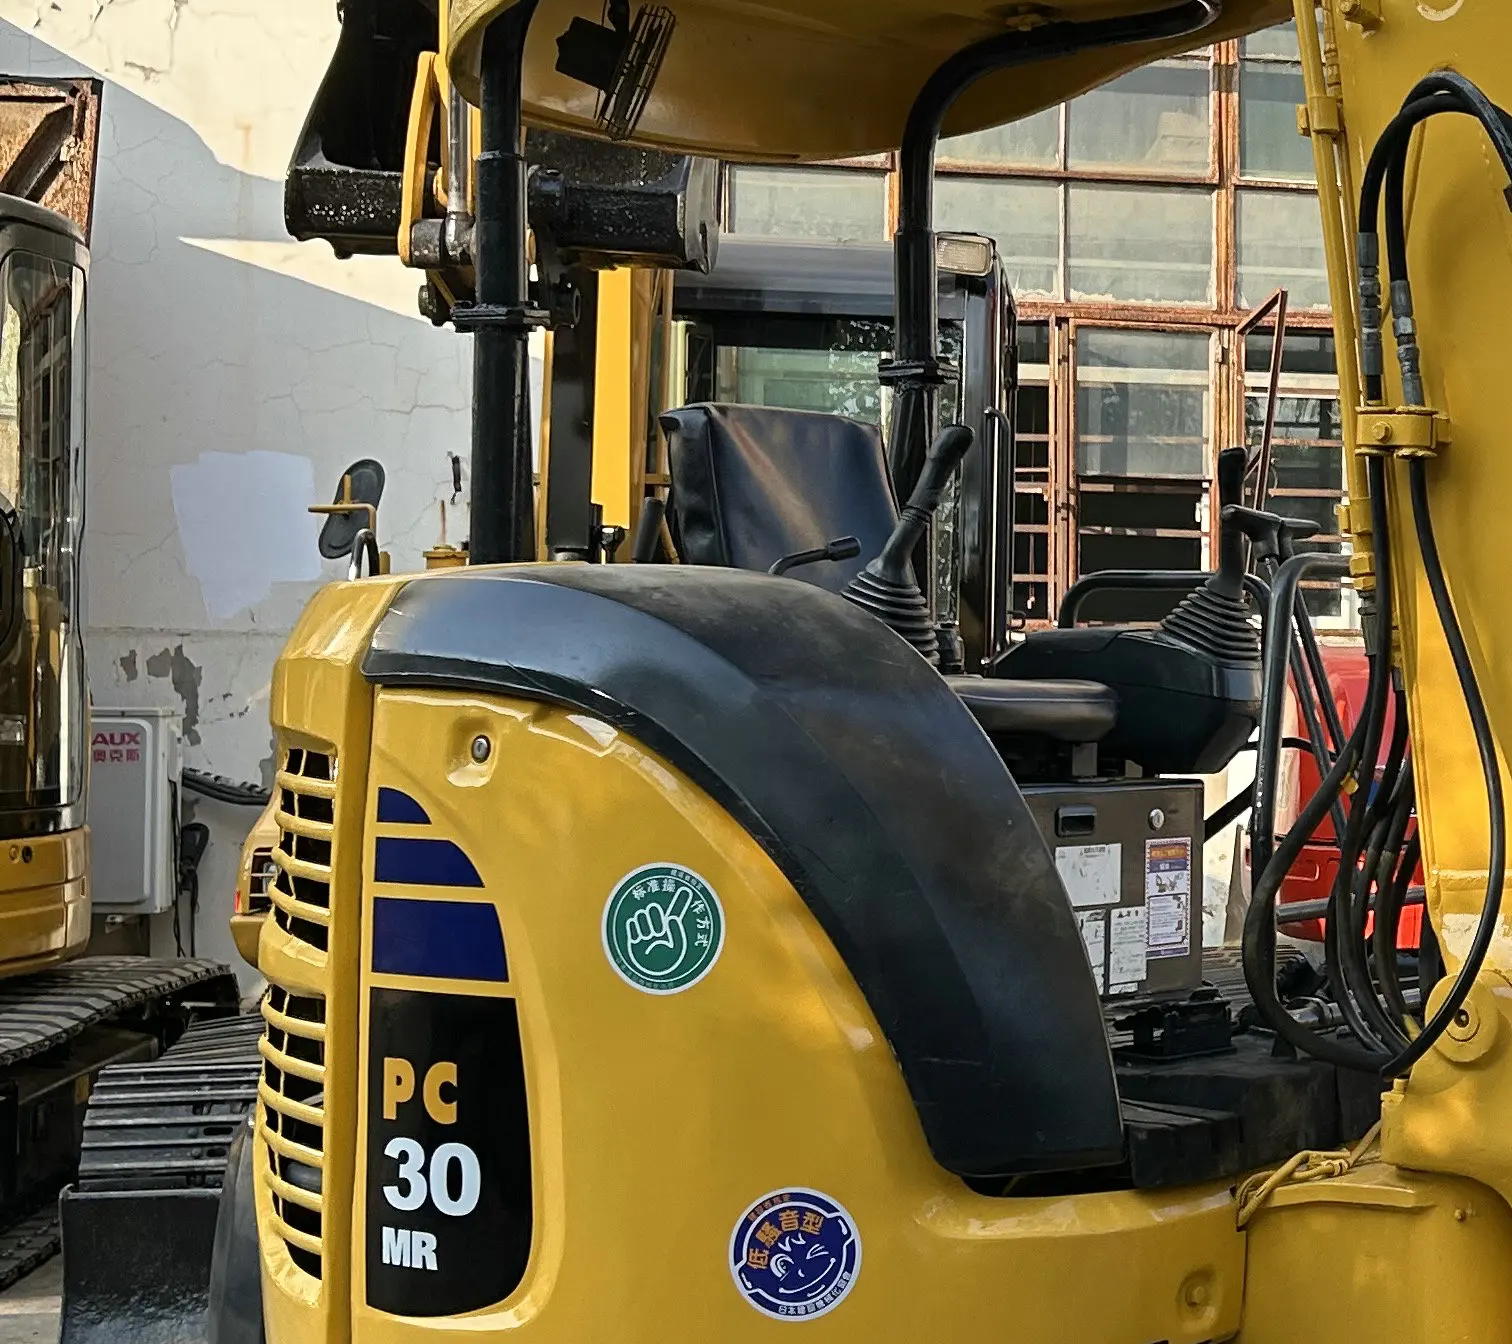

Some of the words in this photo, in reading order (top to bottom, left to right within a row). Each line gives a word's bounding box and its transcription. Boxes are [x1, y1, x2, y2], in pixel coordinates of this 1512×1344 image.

[91, 731, 140, 746] AUX
[383, 1056, 458, 1125] PC
[382, 1136, 482, 1217] 30
[381, 1226, 439, 1271] MR
